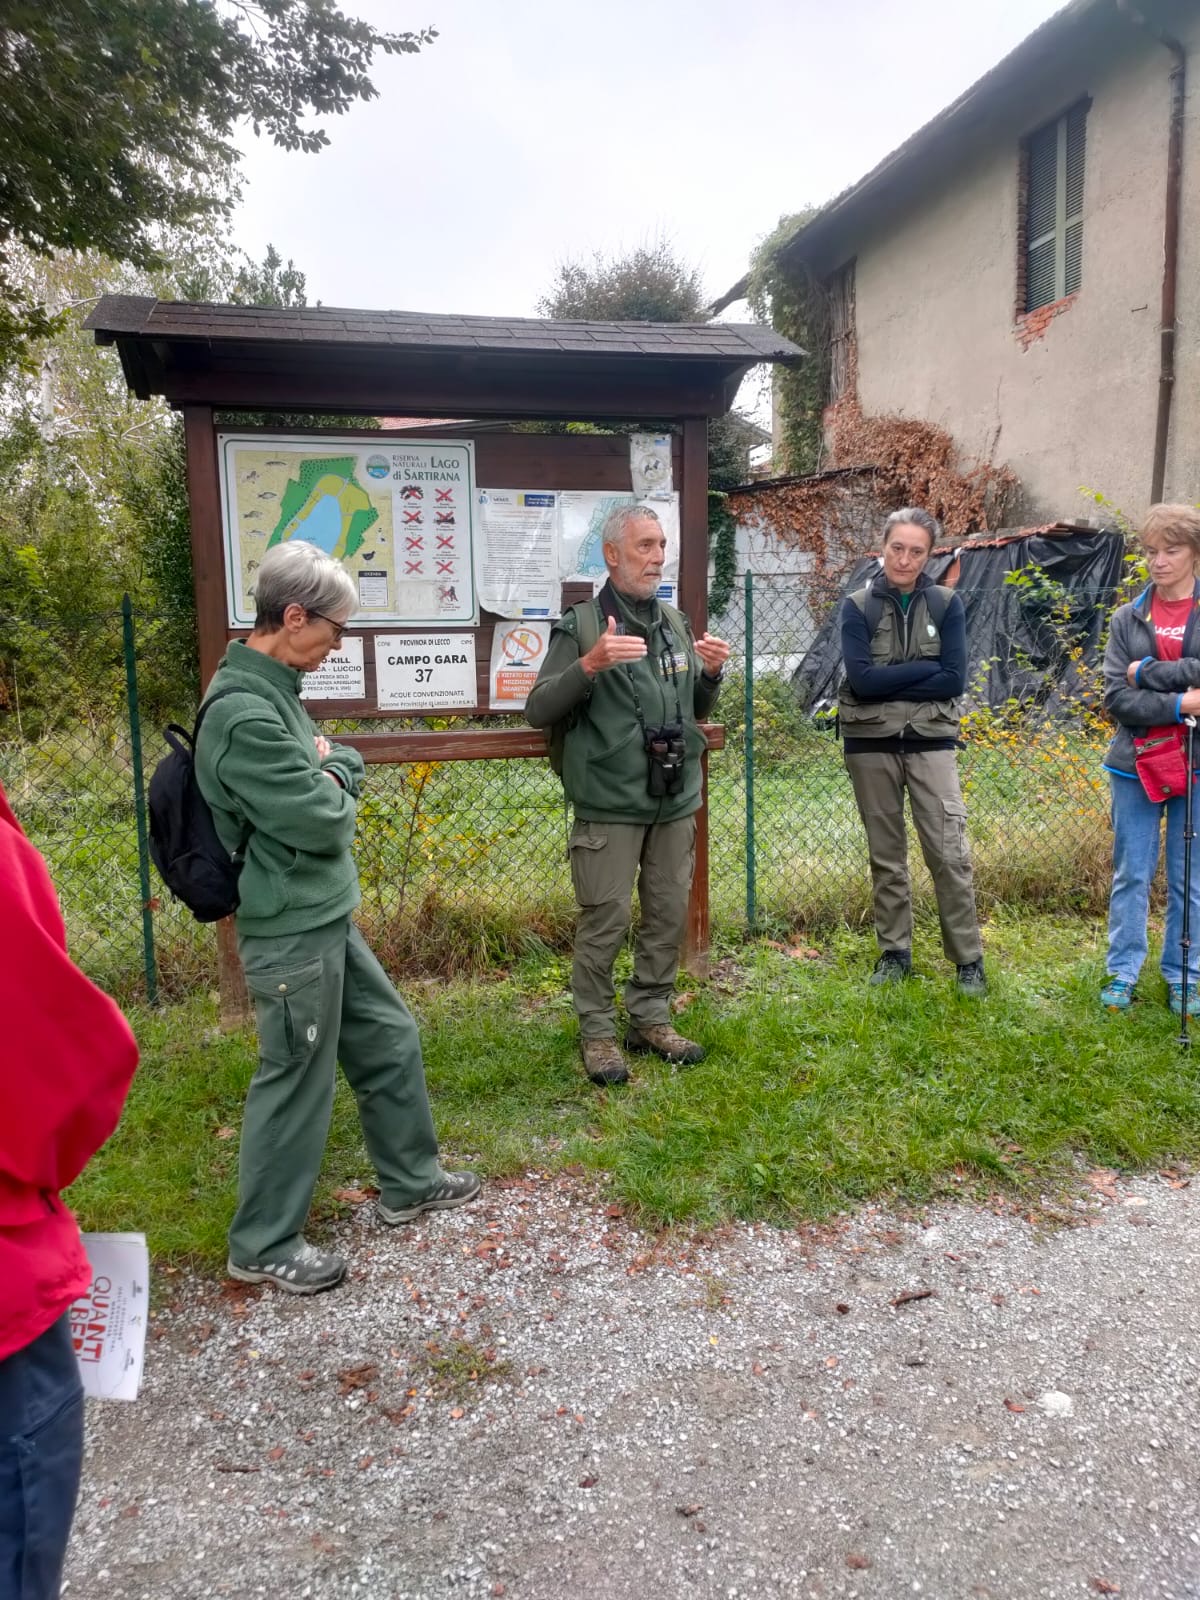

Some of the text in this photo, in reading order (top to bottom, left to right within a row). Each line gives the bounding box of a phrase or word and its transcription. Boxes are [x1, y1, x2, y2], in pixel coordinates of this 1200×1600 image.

[431, 456, 460, 469] LAGO
[393, 469, 461, 481] di SARTIRANA
[434, 638, 451, 646] LECCO
[387, 654, 468, 666] CAMPO GARA
[415, 668, 434, 683] 37
[413, 690, 465, 698] CONVENZIONATE
[81, 1275, 112, 1363] QUANTI
